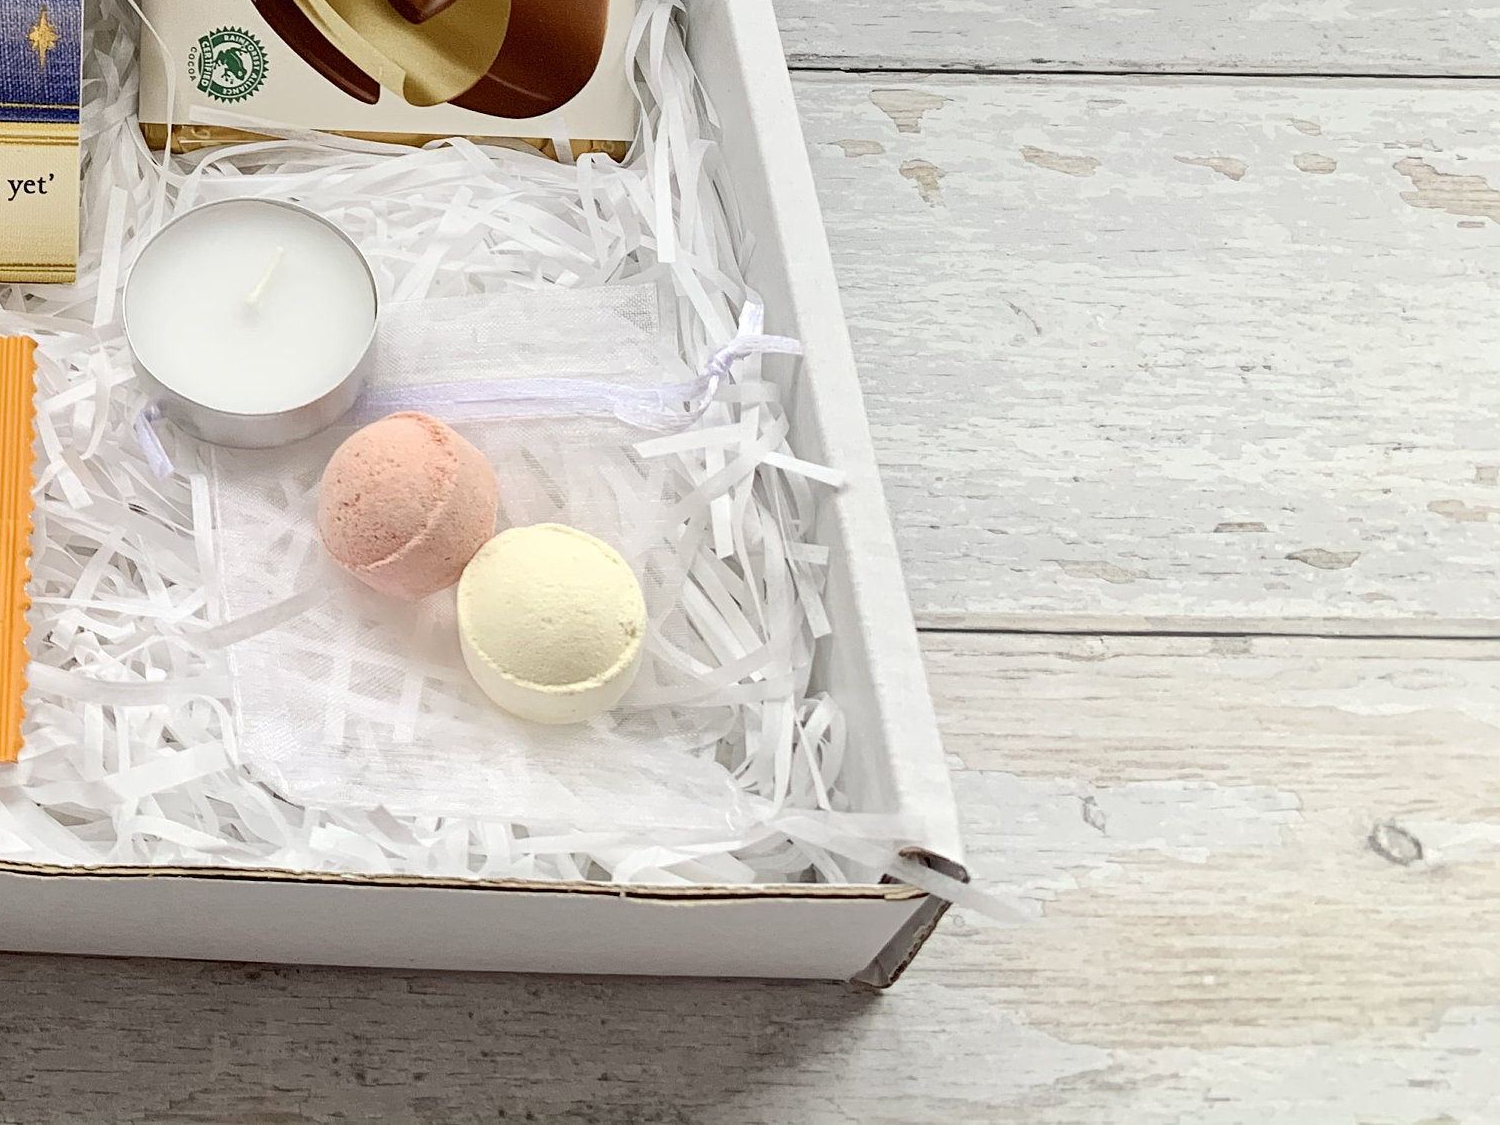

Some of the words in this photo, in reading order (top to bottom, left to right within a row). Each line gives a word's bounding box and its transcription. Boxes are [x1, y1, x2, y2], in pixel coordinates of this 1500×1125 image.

[187, 46, 198, 81] COCOA
[201, 41, 213, 87] CERTIFIED
[224, 35, 260, 70] RAINFOREST
[223, 72, 257, 95] ALLIANCE
